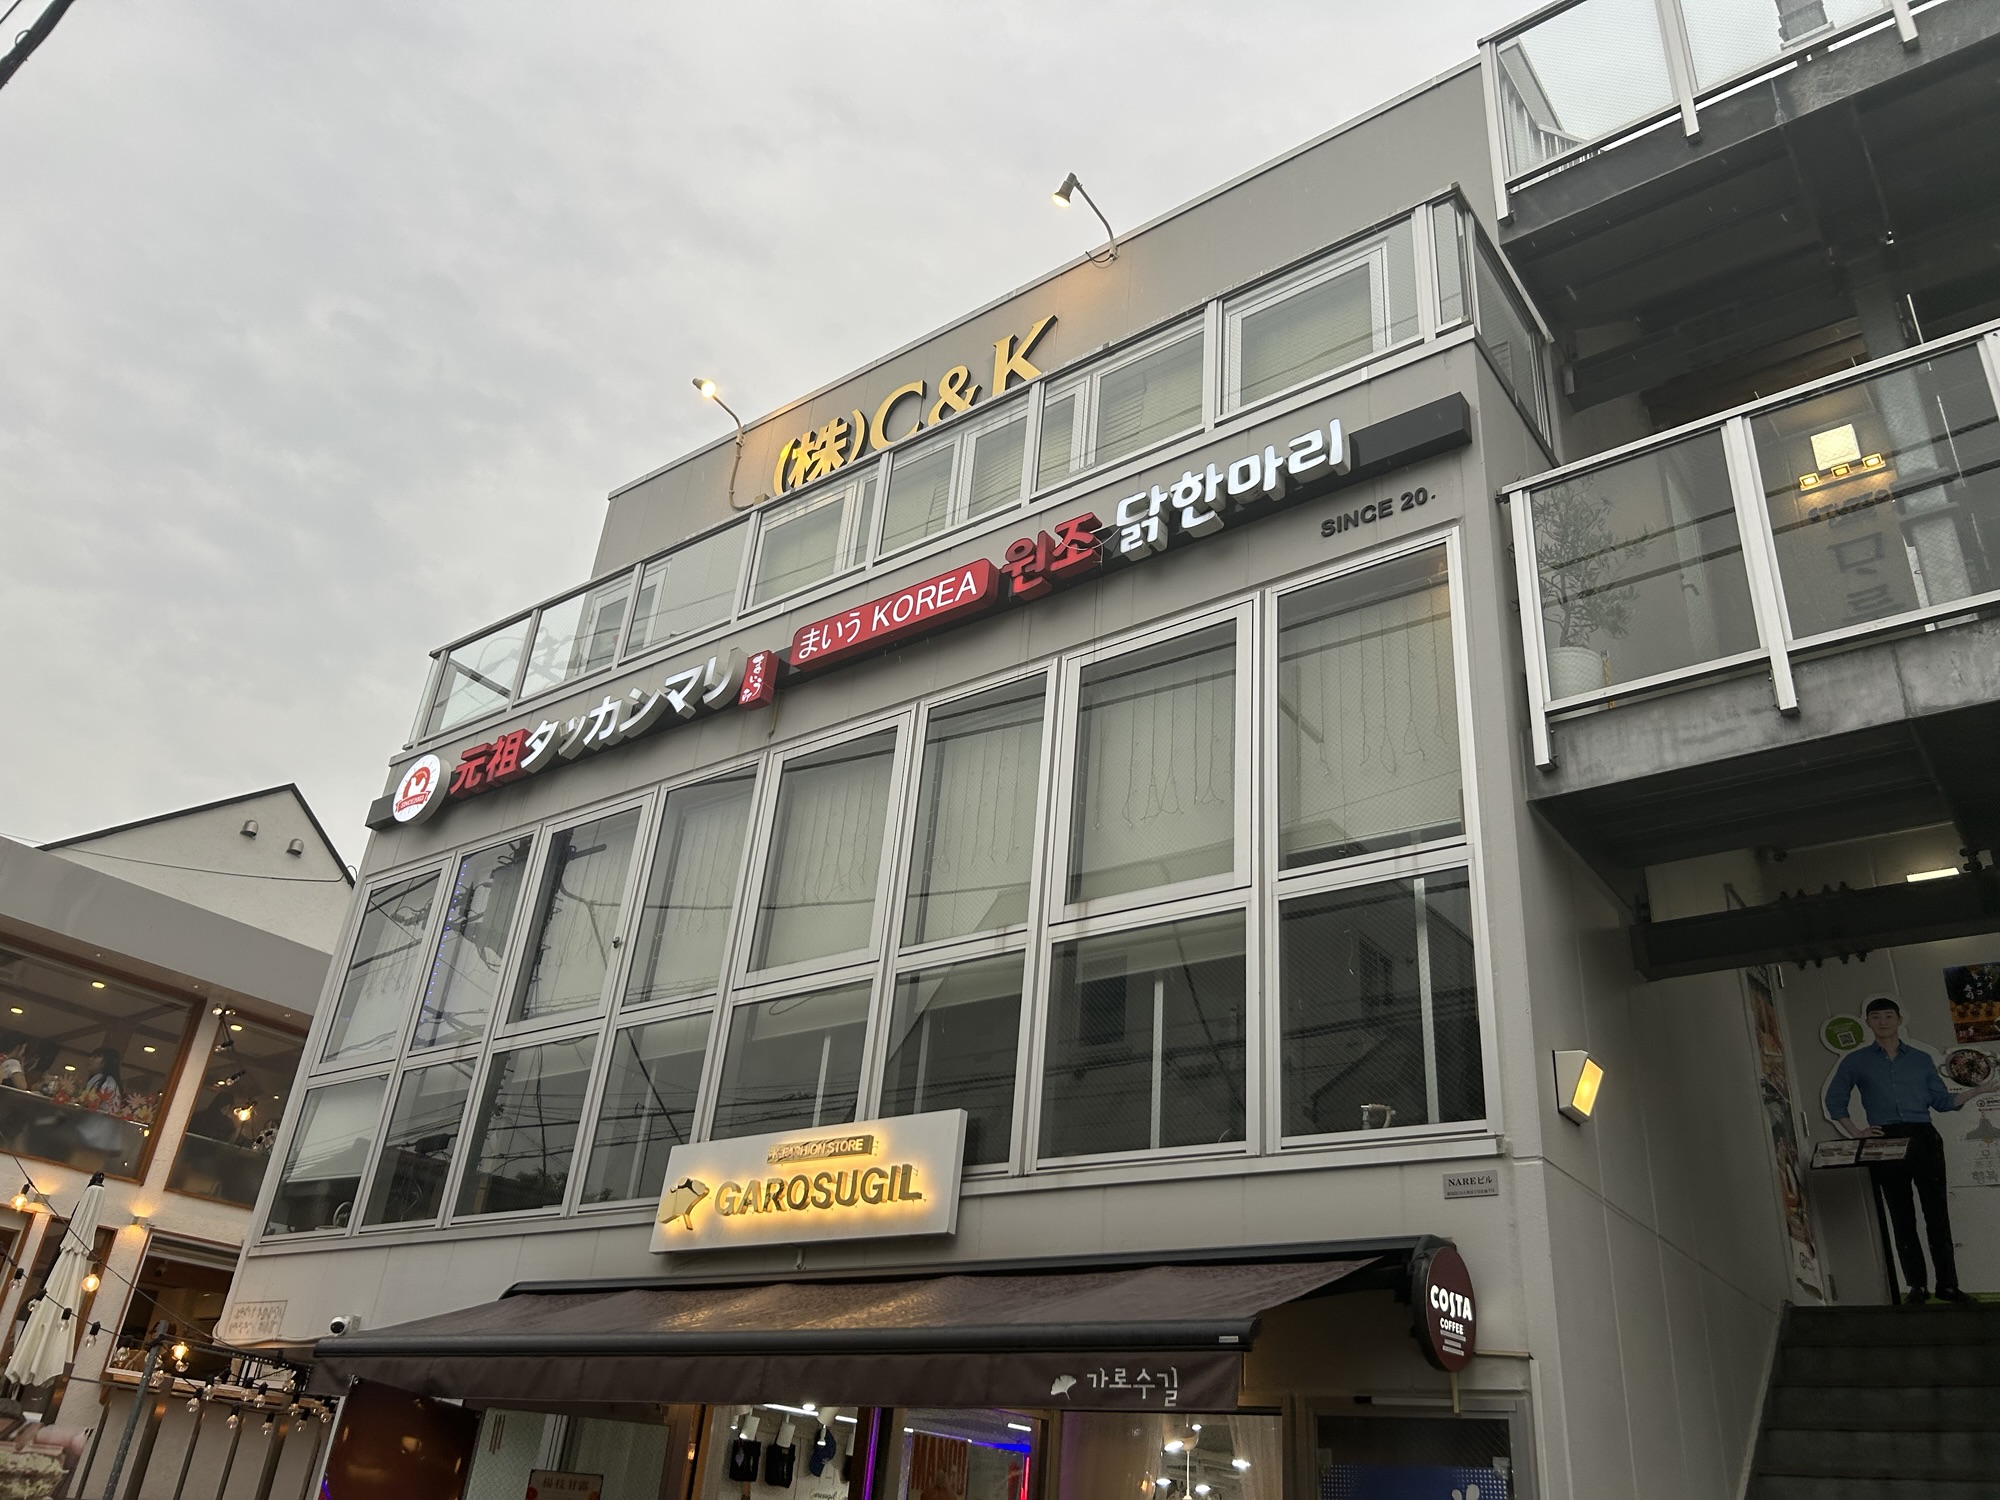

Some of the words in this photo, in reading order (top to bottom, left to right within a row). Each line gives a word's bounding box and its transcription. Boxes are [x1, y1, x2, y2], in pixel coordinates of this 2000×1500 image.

[1001, 512, 1102, 591] 원조
[1115, 418, 1344, 555] 닭한마리
[1320, 498, 1394, 537] SINCE
[798, 609, 862, 660] まいう
[871, 570, 978, 632] KOREA
[826, 1138, 865, 1155] STORE
[714, 1163, 924, 1217] GAROSUGIL
[1447, 1175, 1493, 1187] NAREビル
[1430, 1284, 1473, 1321] COSTA
[1439, 1317, 1464, 1335] COFFEE
[1087, 1367, 1179, 1408] 가로수길
